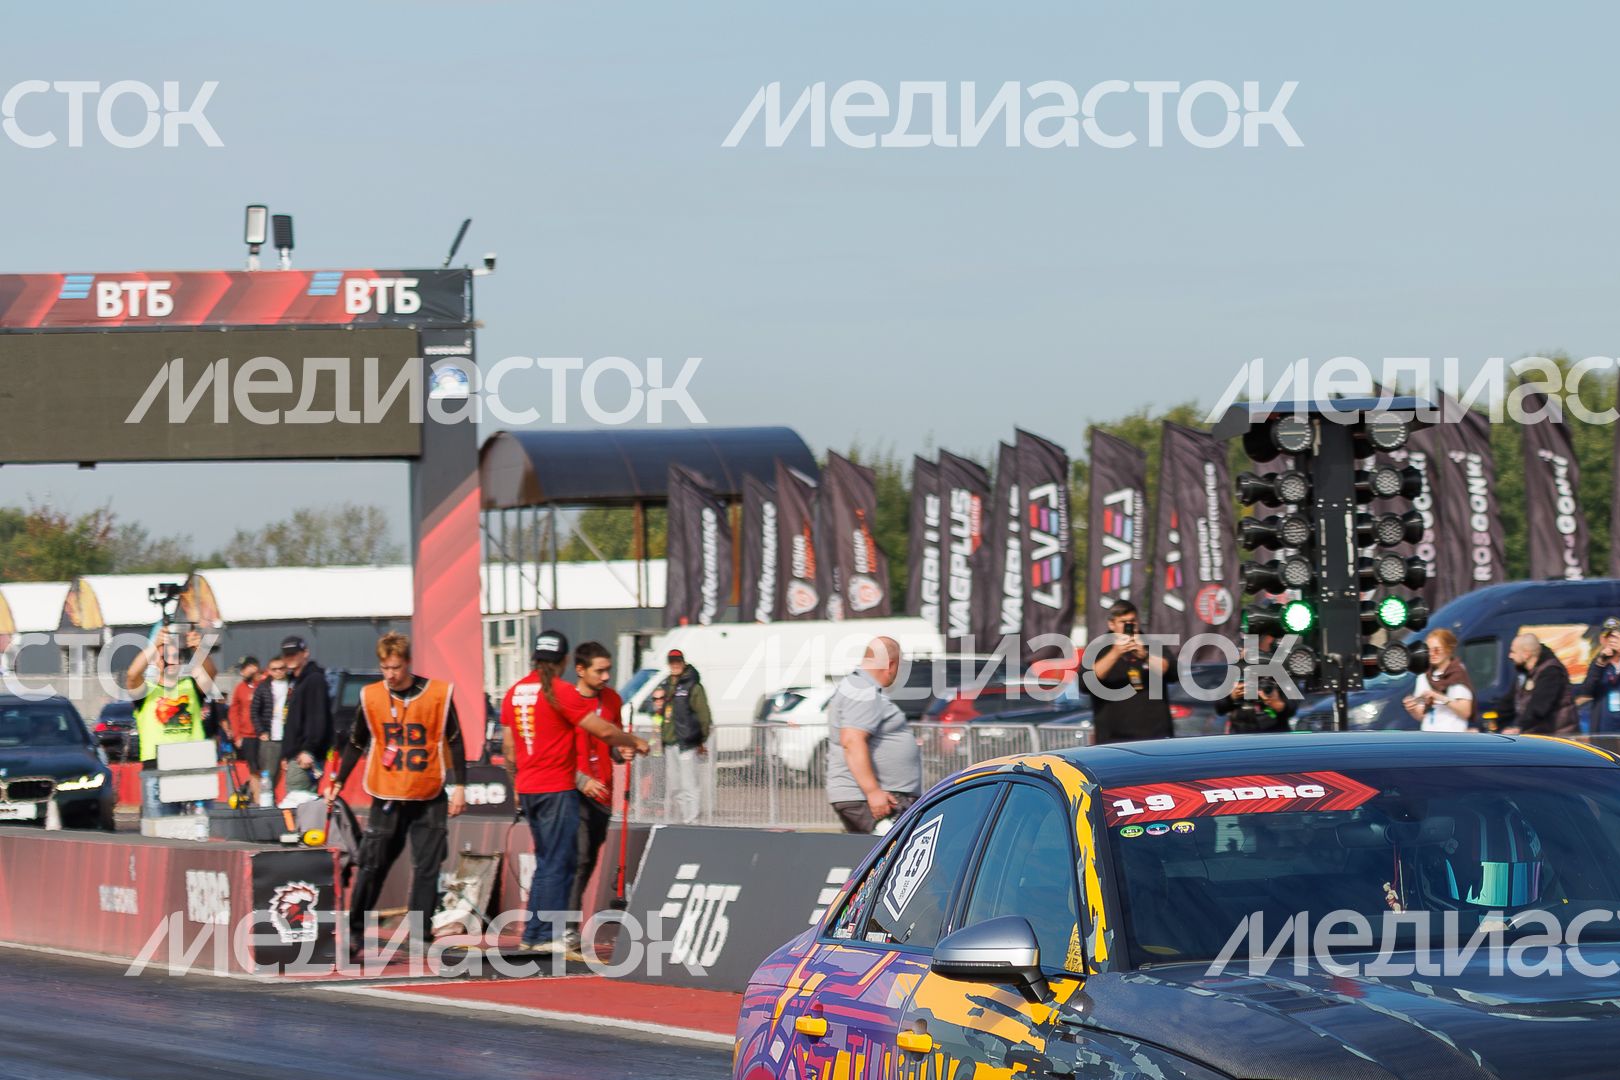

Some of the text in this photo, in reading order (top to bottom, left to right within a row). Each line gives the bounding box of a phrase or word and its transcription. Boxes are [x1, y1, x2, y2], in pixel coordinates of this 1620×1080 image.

[96, 280, 175, 318] ВТБ
[344, 277, 421, 314] ВТБ
[948, 487, 973, 638] VAGPLUS
[383, 723, 427, 746] RD
[445, 782, 507, 805] RC
[1112, 784, 1327, 818] 19 RDRC
[669, 883, 742, 967] ВТБ
